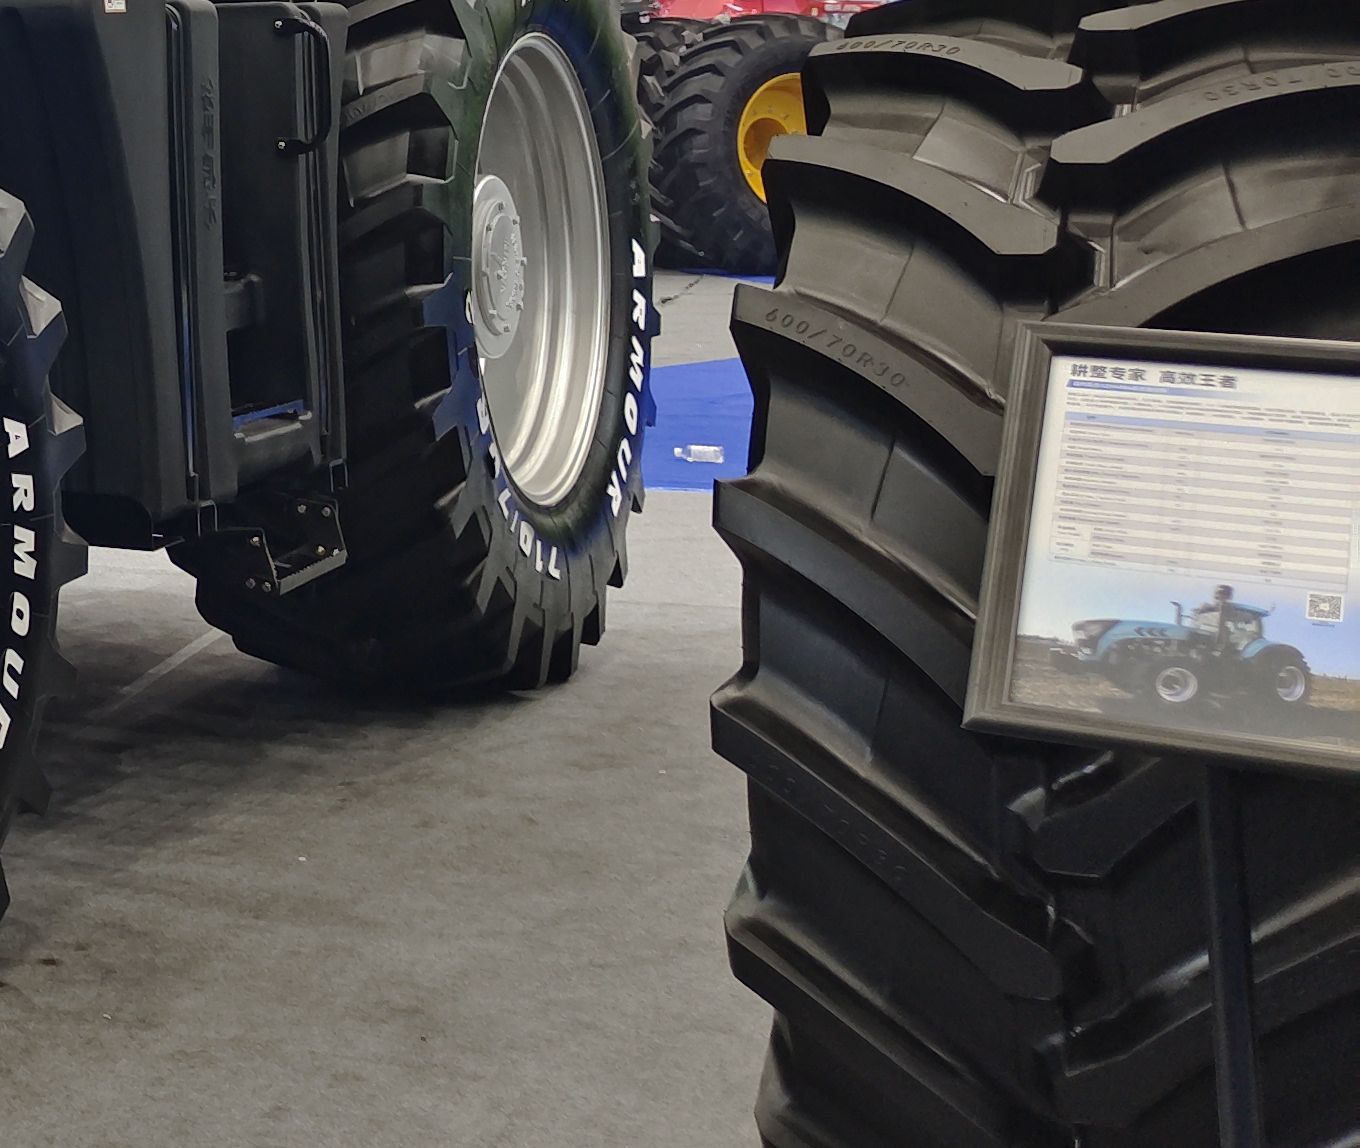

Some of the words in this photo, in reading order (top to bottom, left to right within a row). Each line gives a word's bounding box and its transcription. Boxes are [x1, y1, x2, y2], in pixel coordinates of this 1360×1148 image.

[836, 40, 961, 56] 600/70R30
[765, 308, 906, 388] 600/70R30
[606, 237, 647, 518] ARMOUR
[1159, 369, 1238, 390] 高效王者
